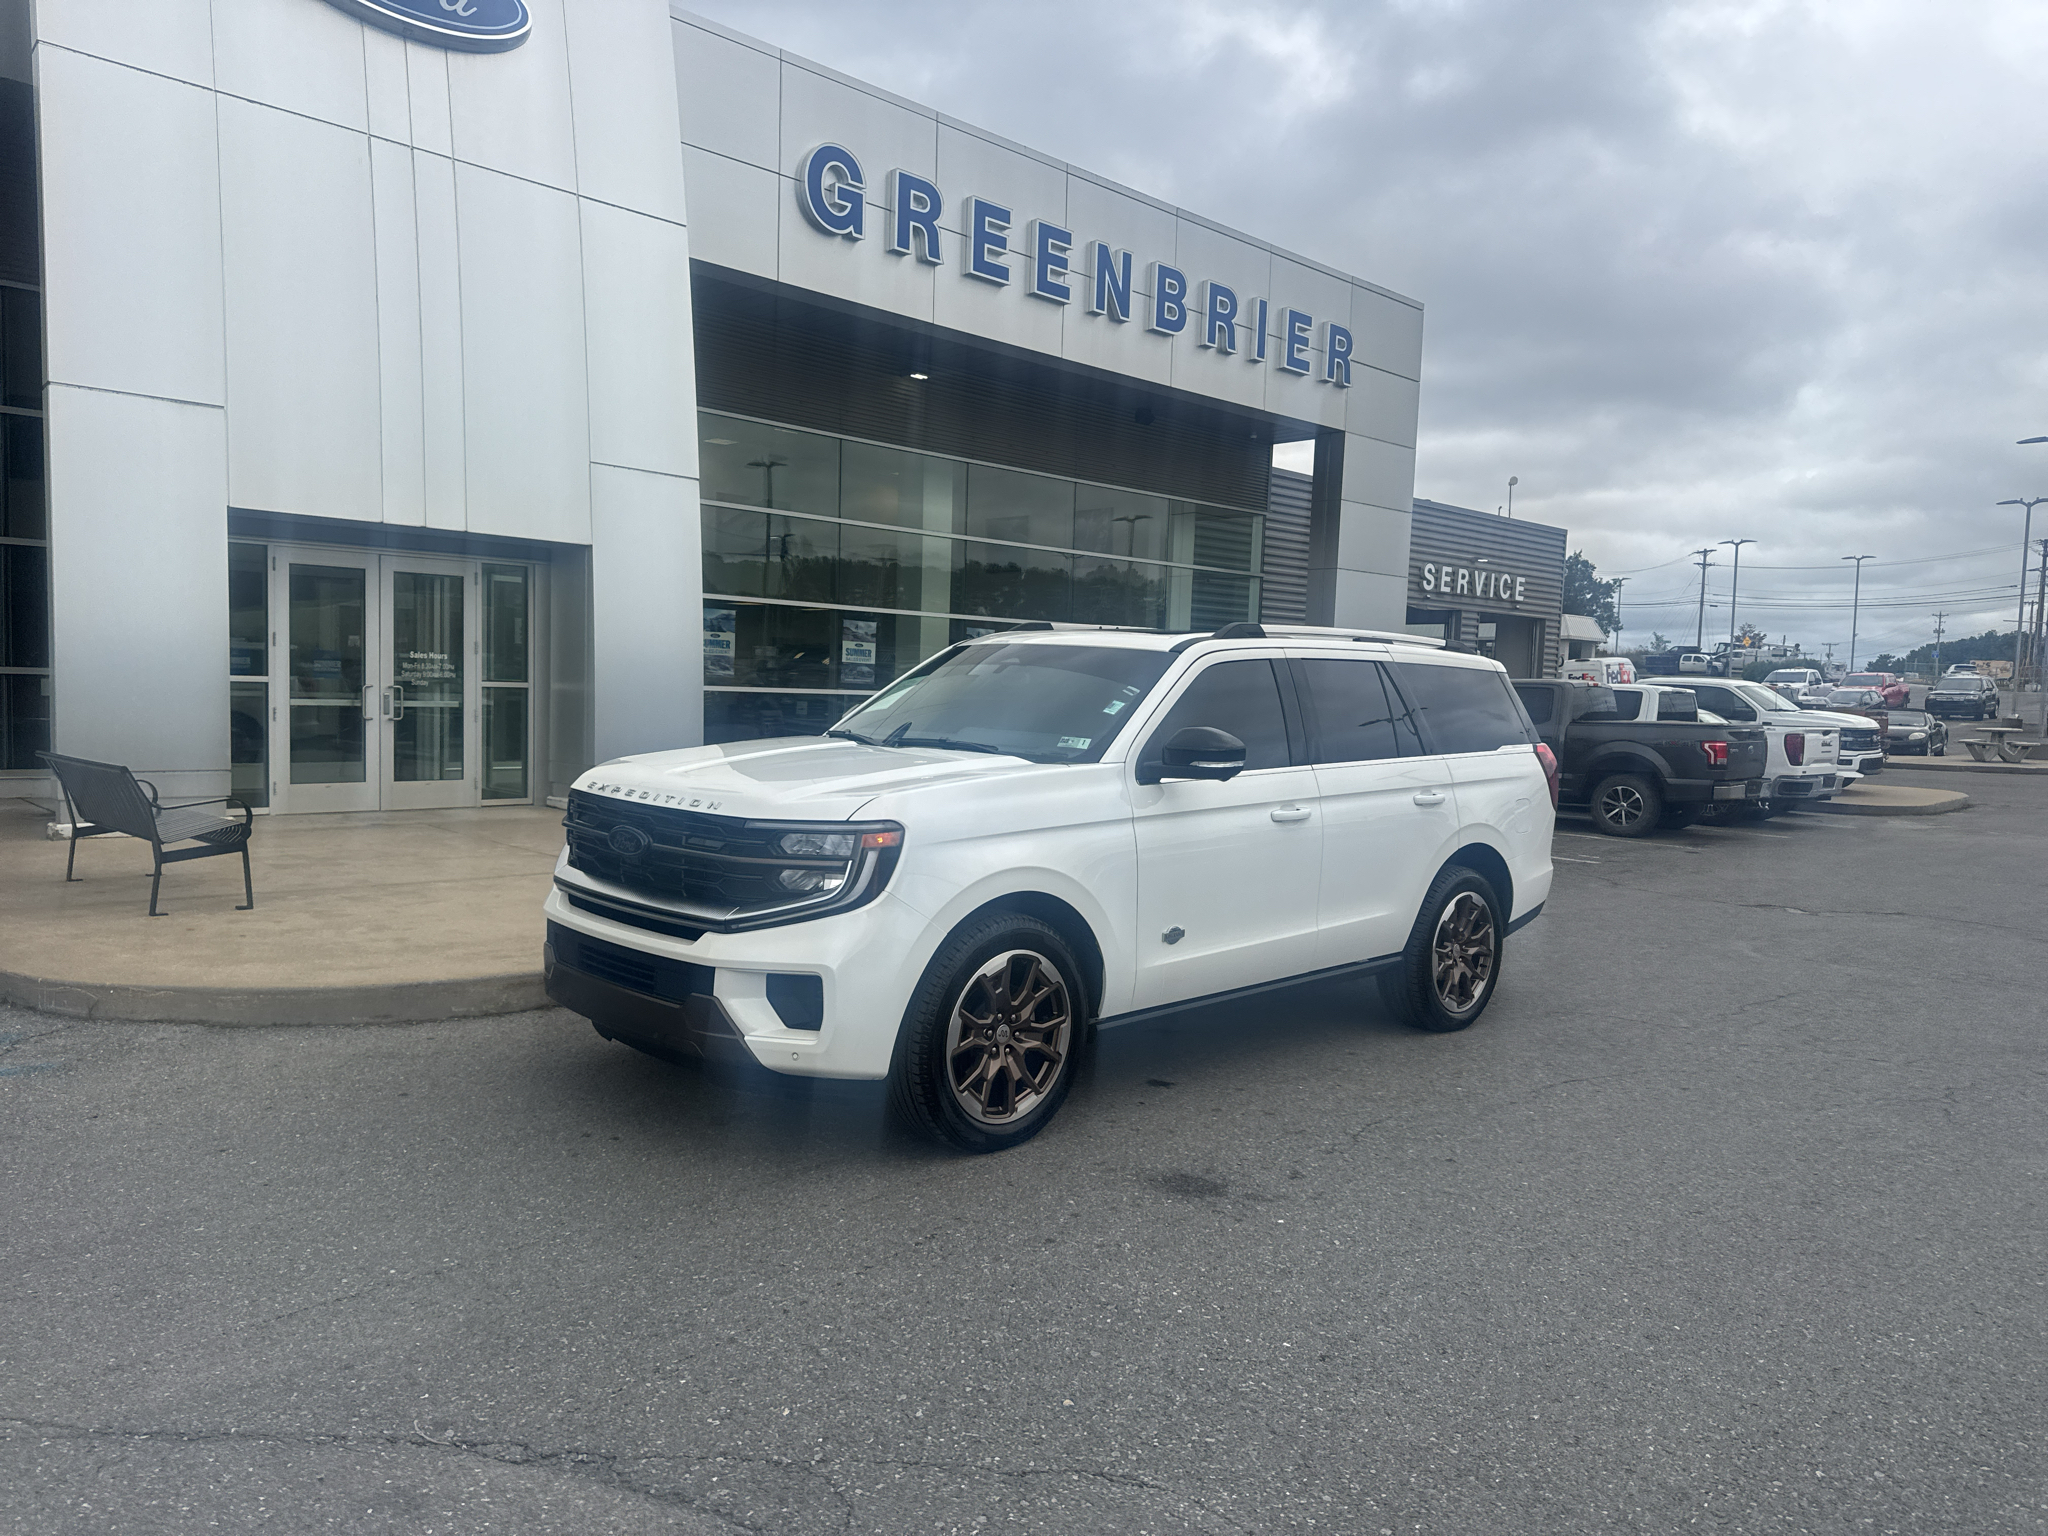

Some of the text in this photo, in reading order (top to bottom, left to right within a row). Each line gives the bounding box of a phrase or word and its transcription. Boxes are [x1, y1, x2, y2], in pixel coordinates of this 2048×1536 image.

[801, 142, 1354, 388] GREENBRIER
[1422, 562, 1527, 602] SERVICE
[410, 651, 448, 660] Sales Hours
[845, 647, 873, 658] SUMMER
[1568, 673, 1596, 682] FedEx
[1605, 663, 1632, 684] FedEx
[587, 781, 722, 810] EXPEDITION
